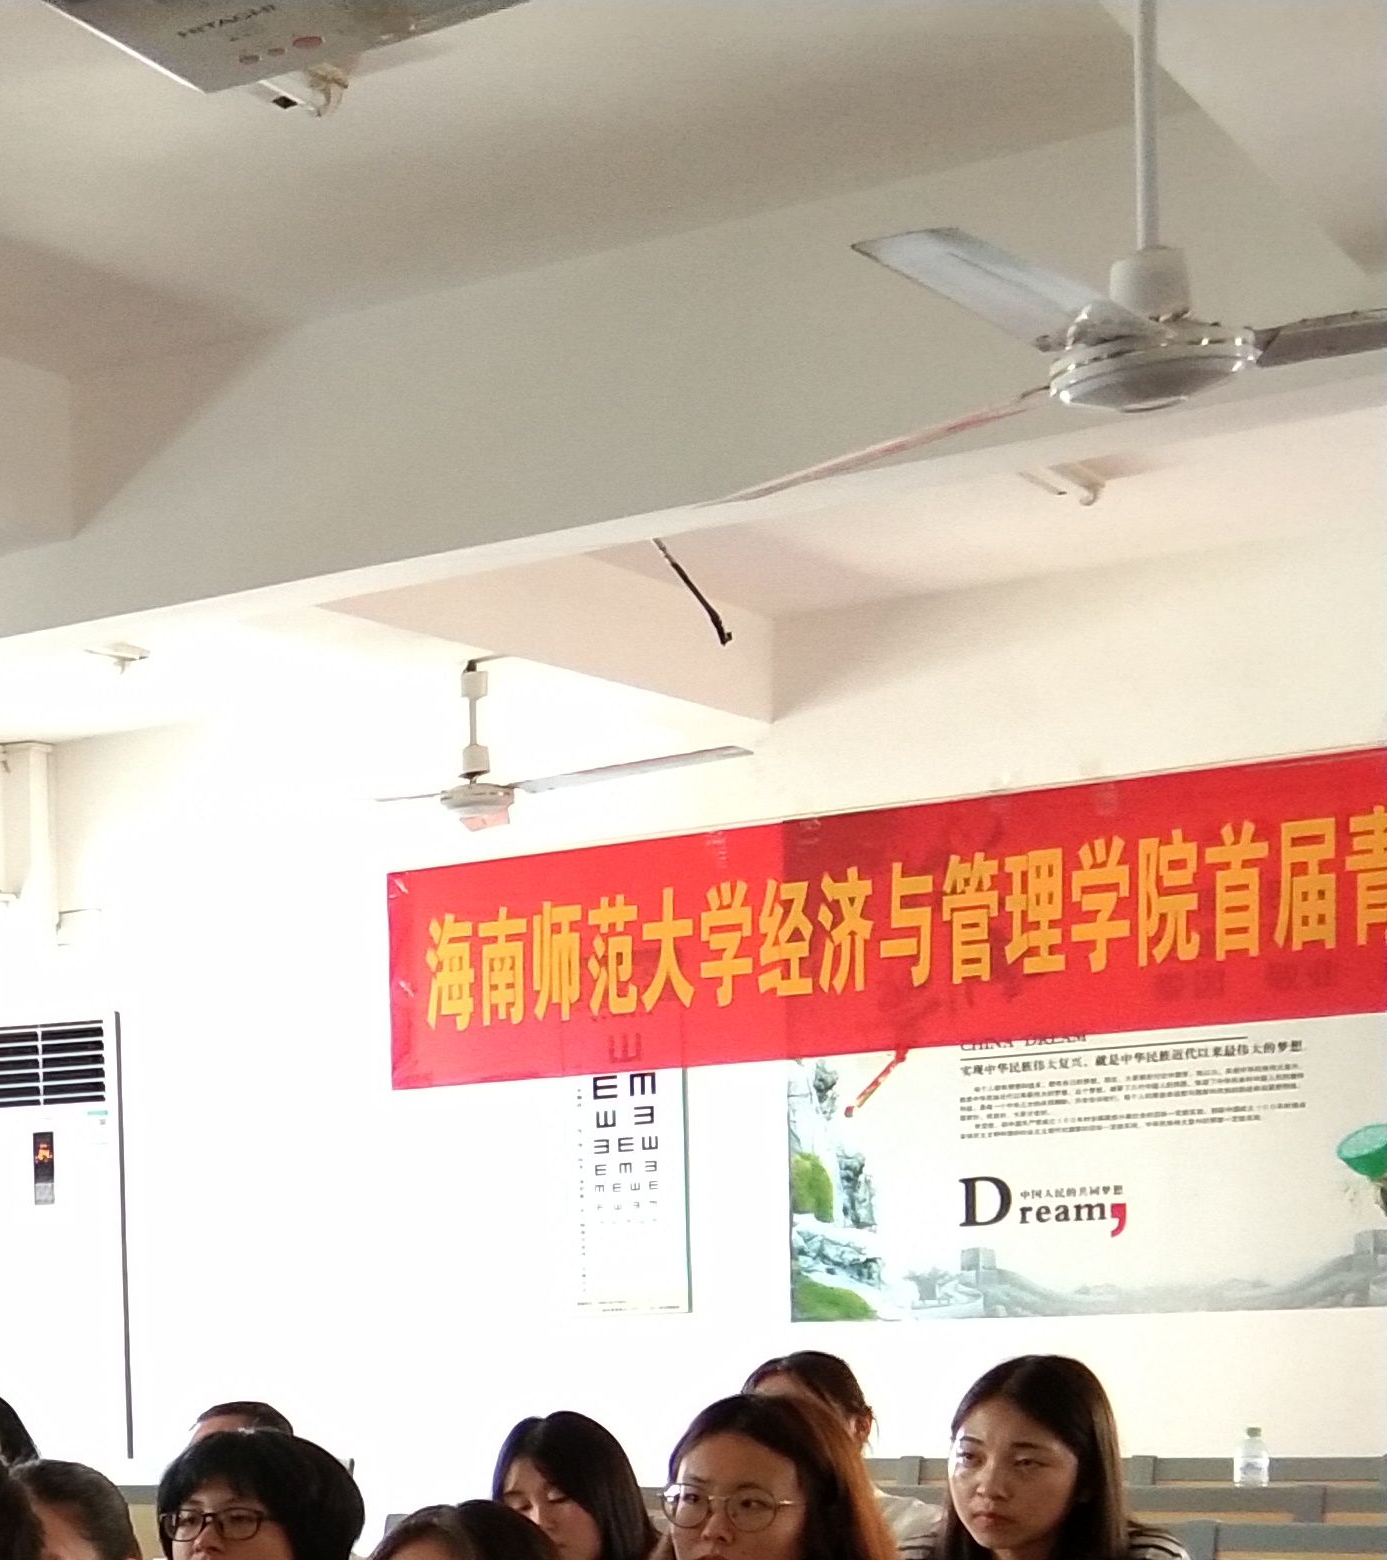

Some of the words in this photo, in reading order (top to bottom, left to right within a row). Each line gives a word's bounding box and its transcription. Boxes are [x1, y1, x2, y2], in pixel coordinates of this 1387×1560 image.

[425, 804, 1387, 1032] 海南师范大学经济与管理学院首届青
